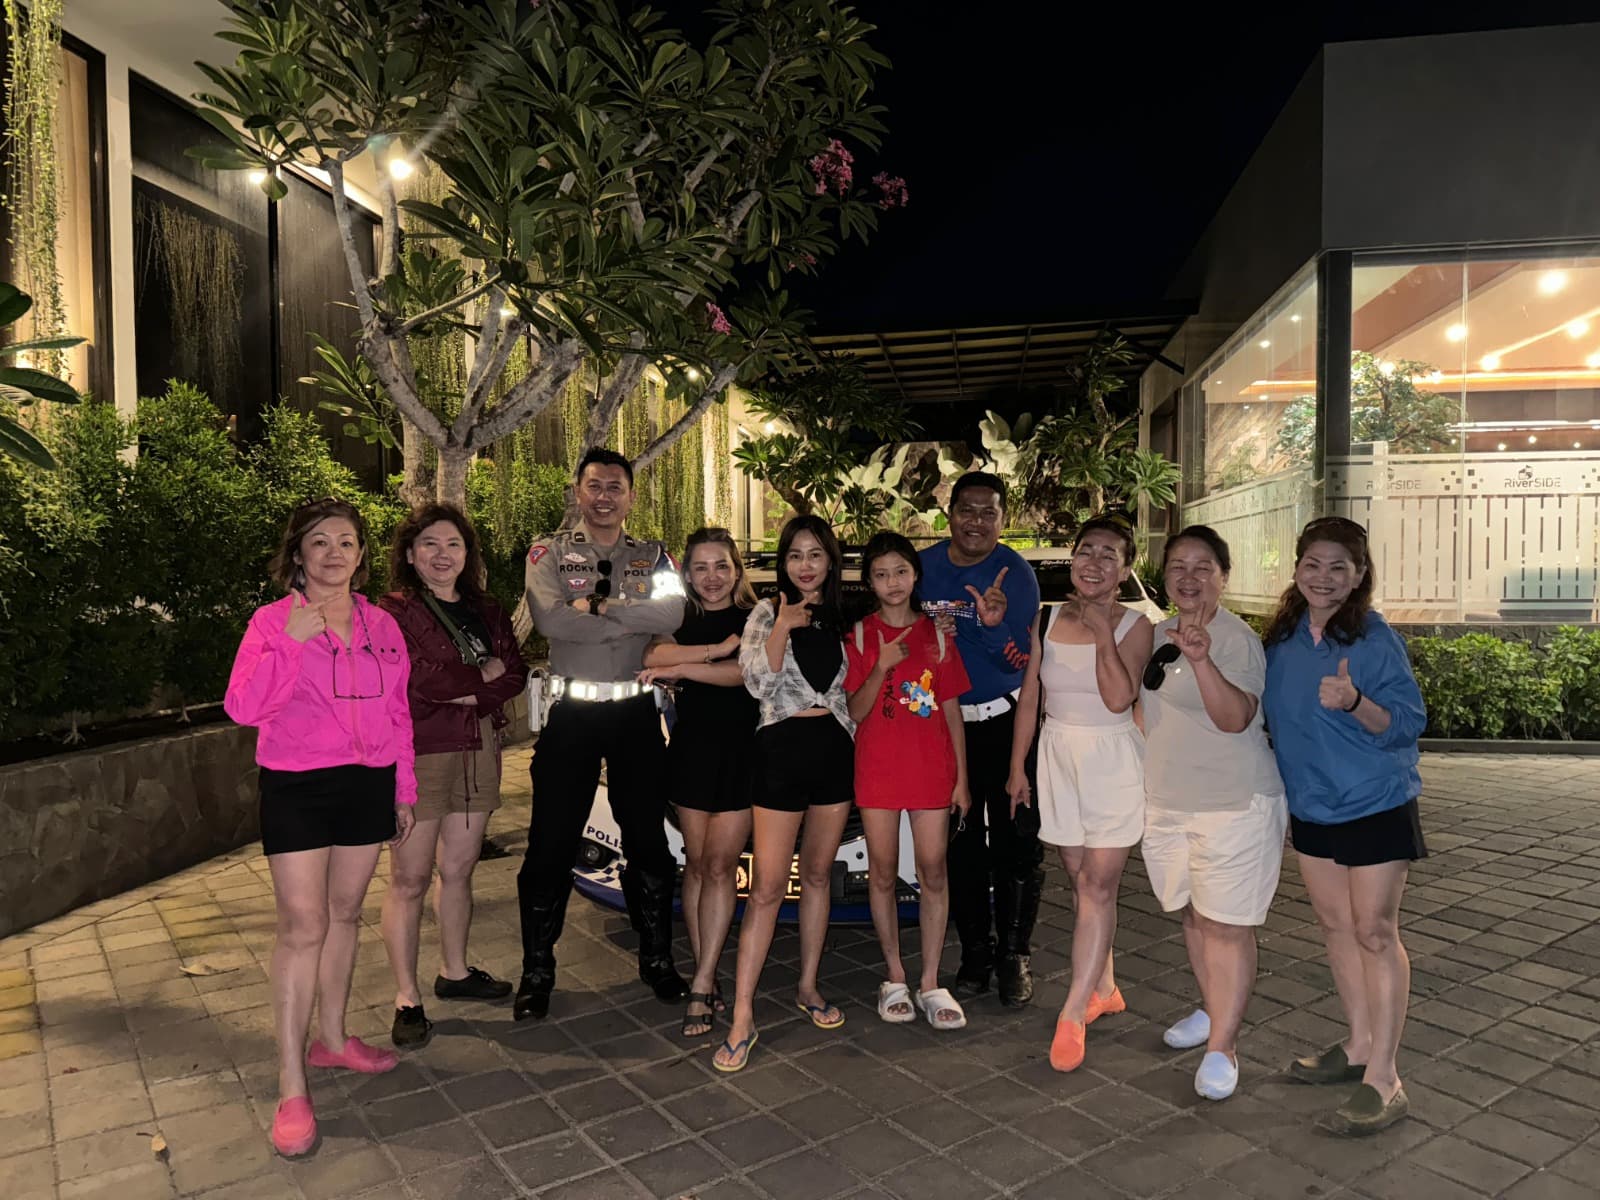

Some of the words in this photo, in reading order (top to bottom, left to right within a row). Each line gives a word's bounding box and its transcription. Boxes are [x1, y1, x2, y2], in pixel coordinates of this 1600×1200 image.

[559, 564, 595, 574] ROCKY
[624, 569, 651, 577] POLI
[586, 825, 621, 848] POLI
